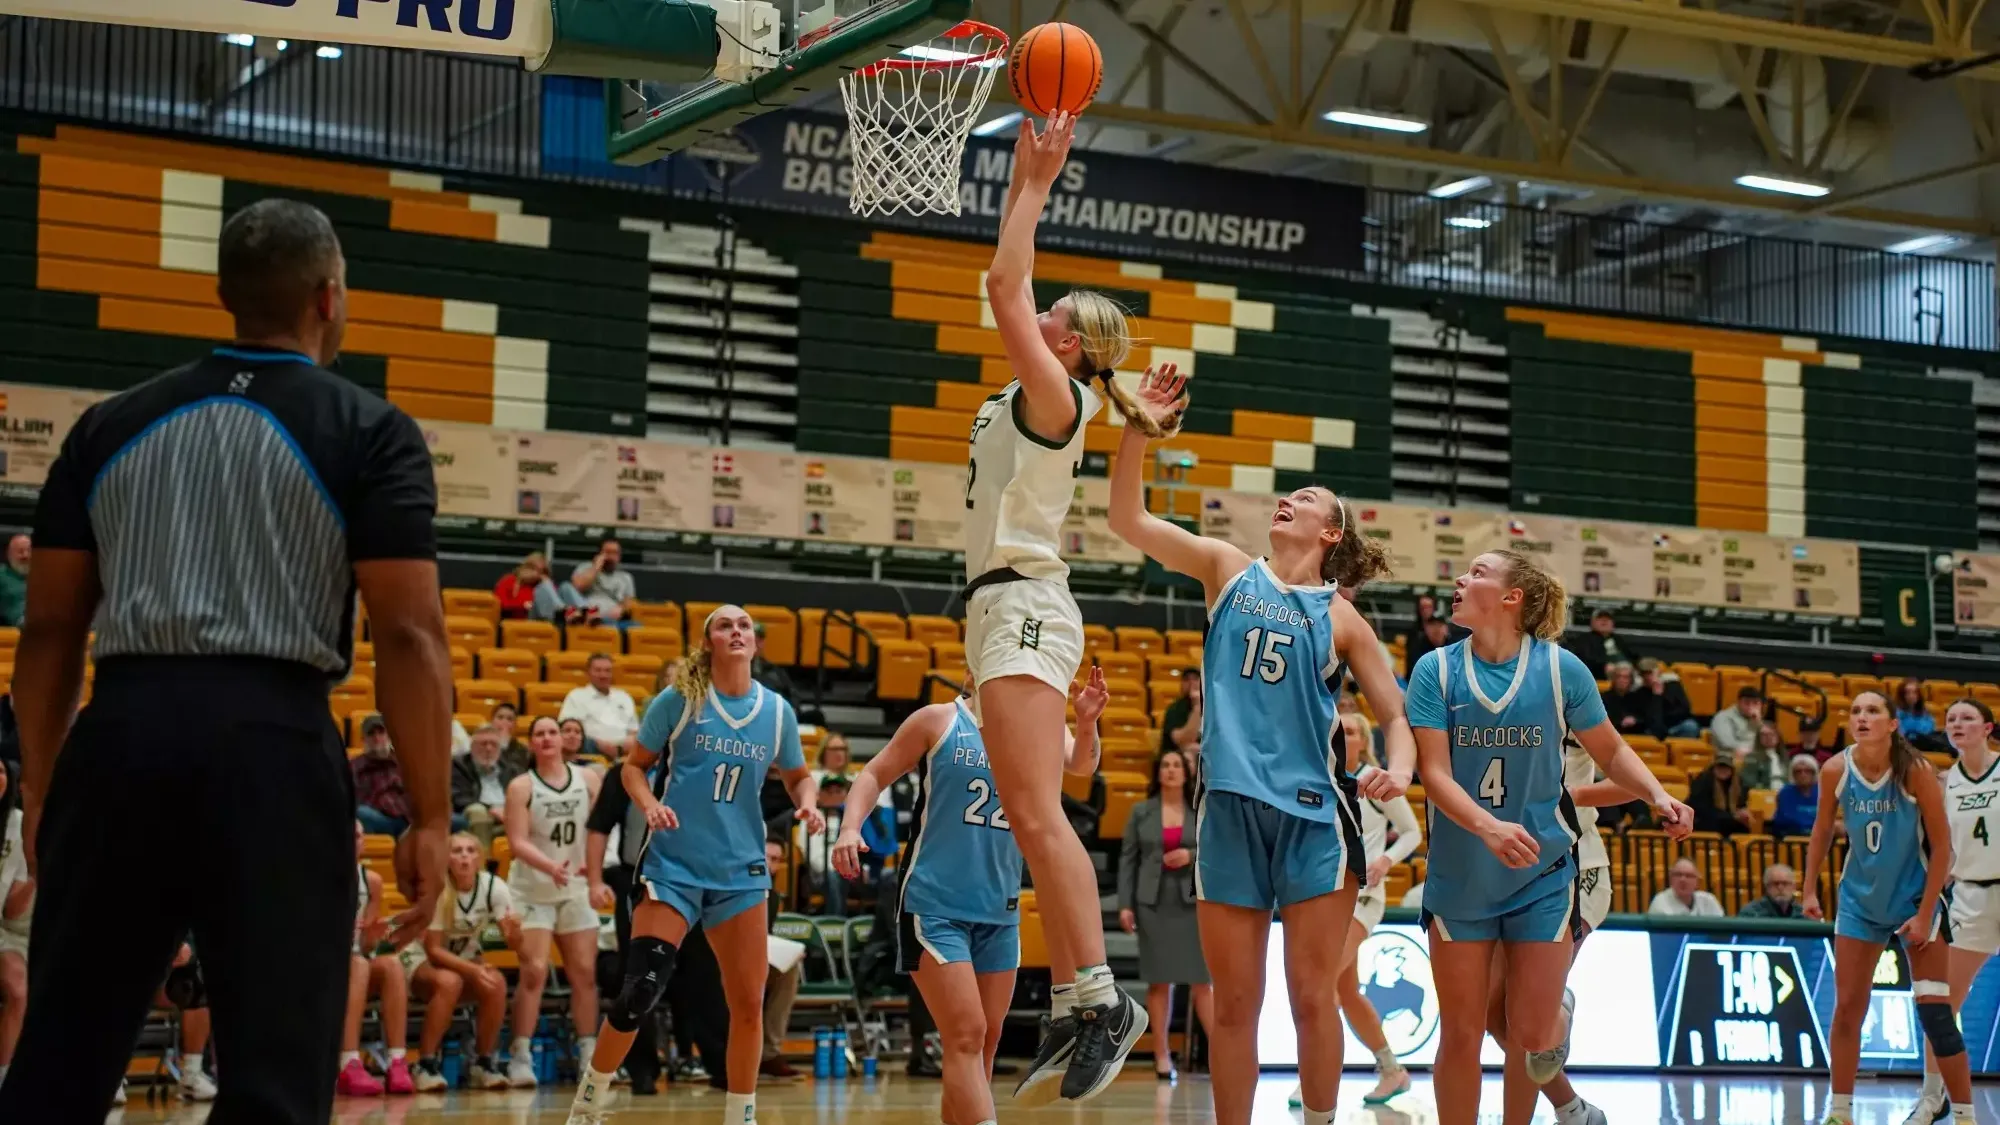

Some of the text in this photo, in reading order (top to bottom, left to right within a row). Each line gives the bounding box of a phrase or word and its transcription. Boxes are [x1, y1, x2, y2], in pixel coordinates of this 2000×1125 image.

[1899, 588, 1917, 628] C
[1240, 627, 1295, 686] 15
[694, 733, 767, 762] PEACOCKS
[1452, 725, 1543, 748] EACOCKS
[953, 747, 992, 770] PEA
[712, 761, 745, 804] 11
[1478, 756, 1507, 809] 4
[549, 820, 577, 848] 40
[1865, 820, 1883, 855] 0
[1972, 815, 1990, 847] 4
